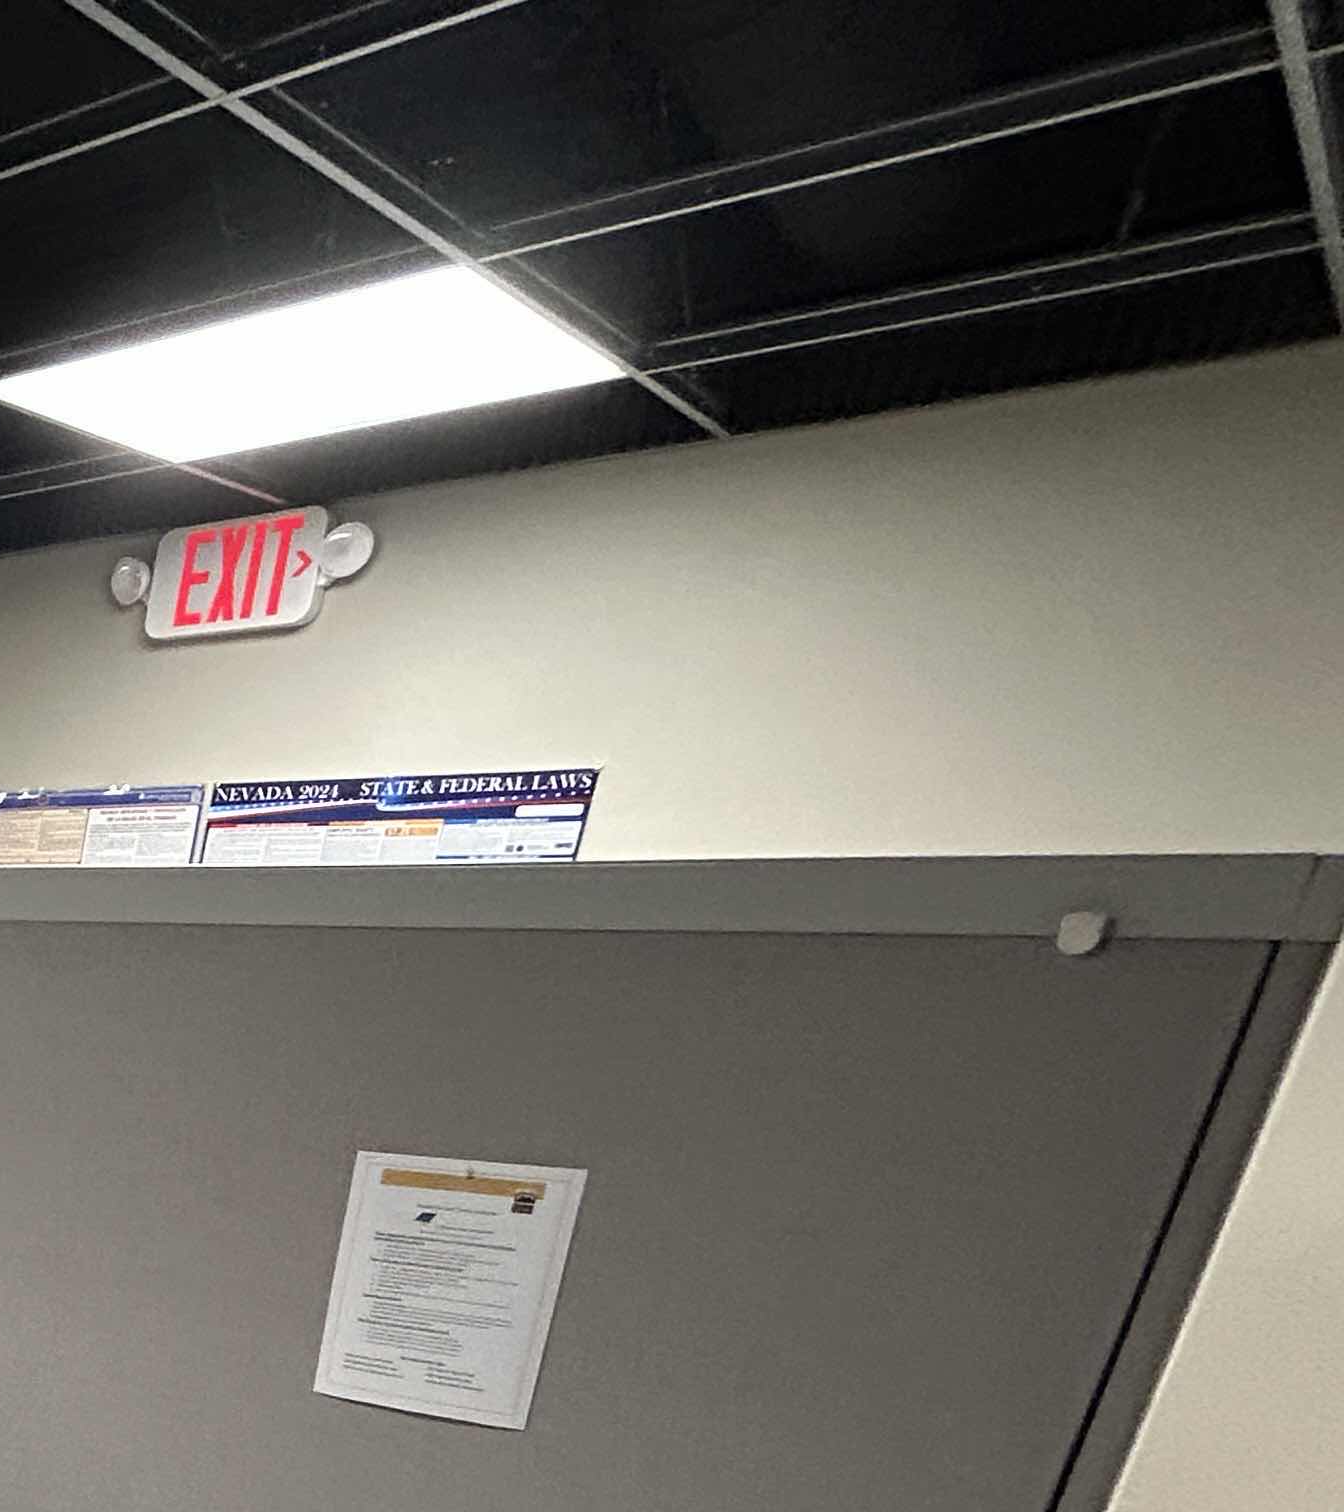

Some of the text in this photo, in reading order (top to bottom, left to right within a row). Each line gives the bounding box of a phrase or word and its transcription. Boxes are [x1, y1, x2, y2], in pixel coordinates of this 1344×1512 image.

[173, 512, 305, 628] EXIT
[215, 772, 594, 802] NEVADA 2024 STATE & FEDERAL LAWS
